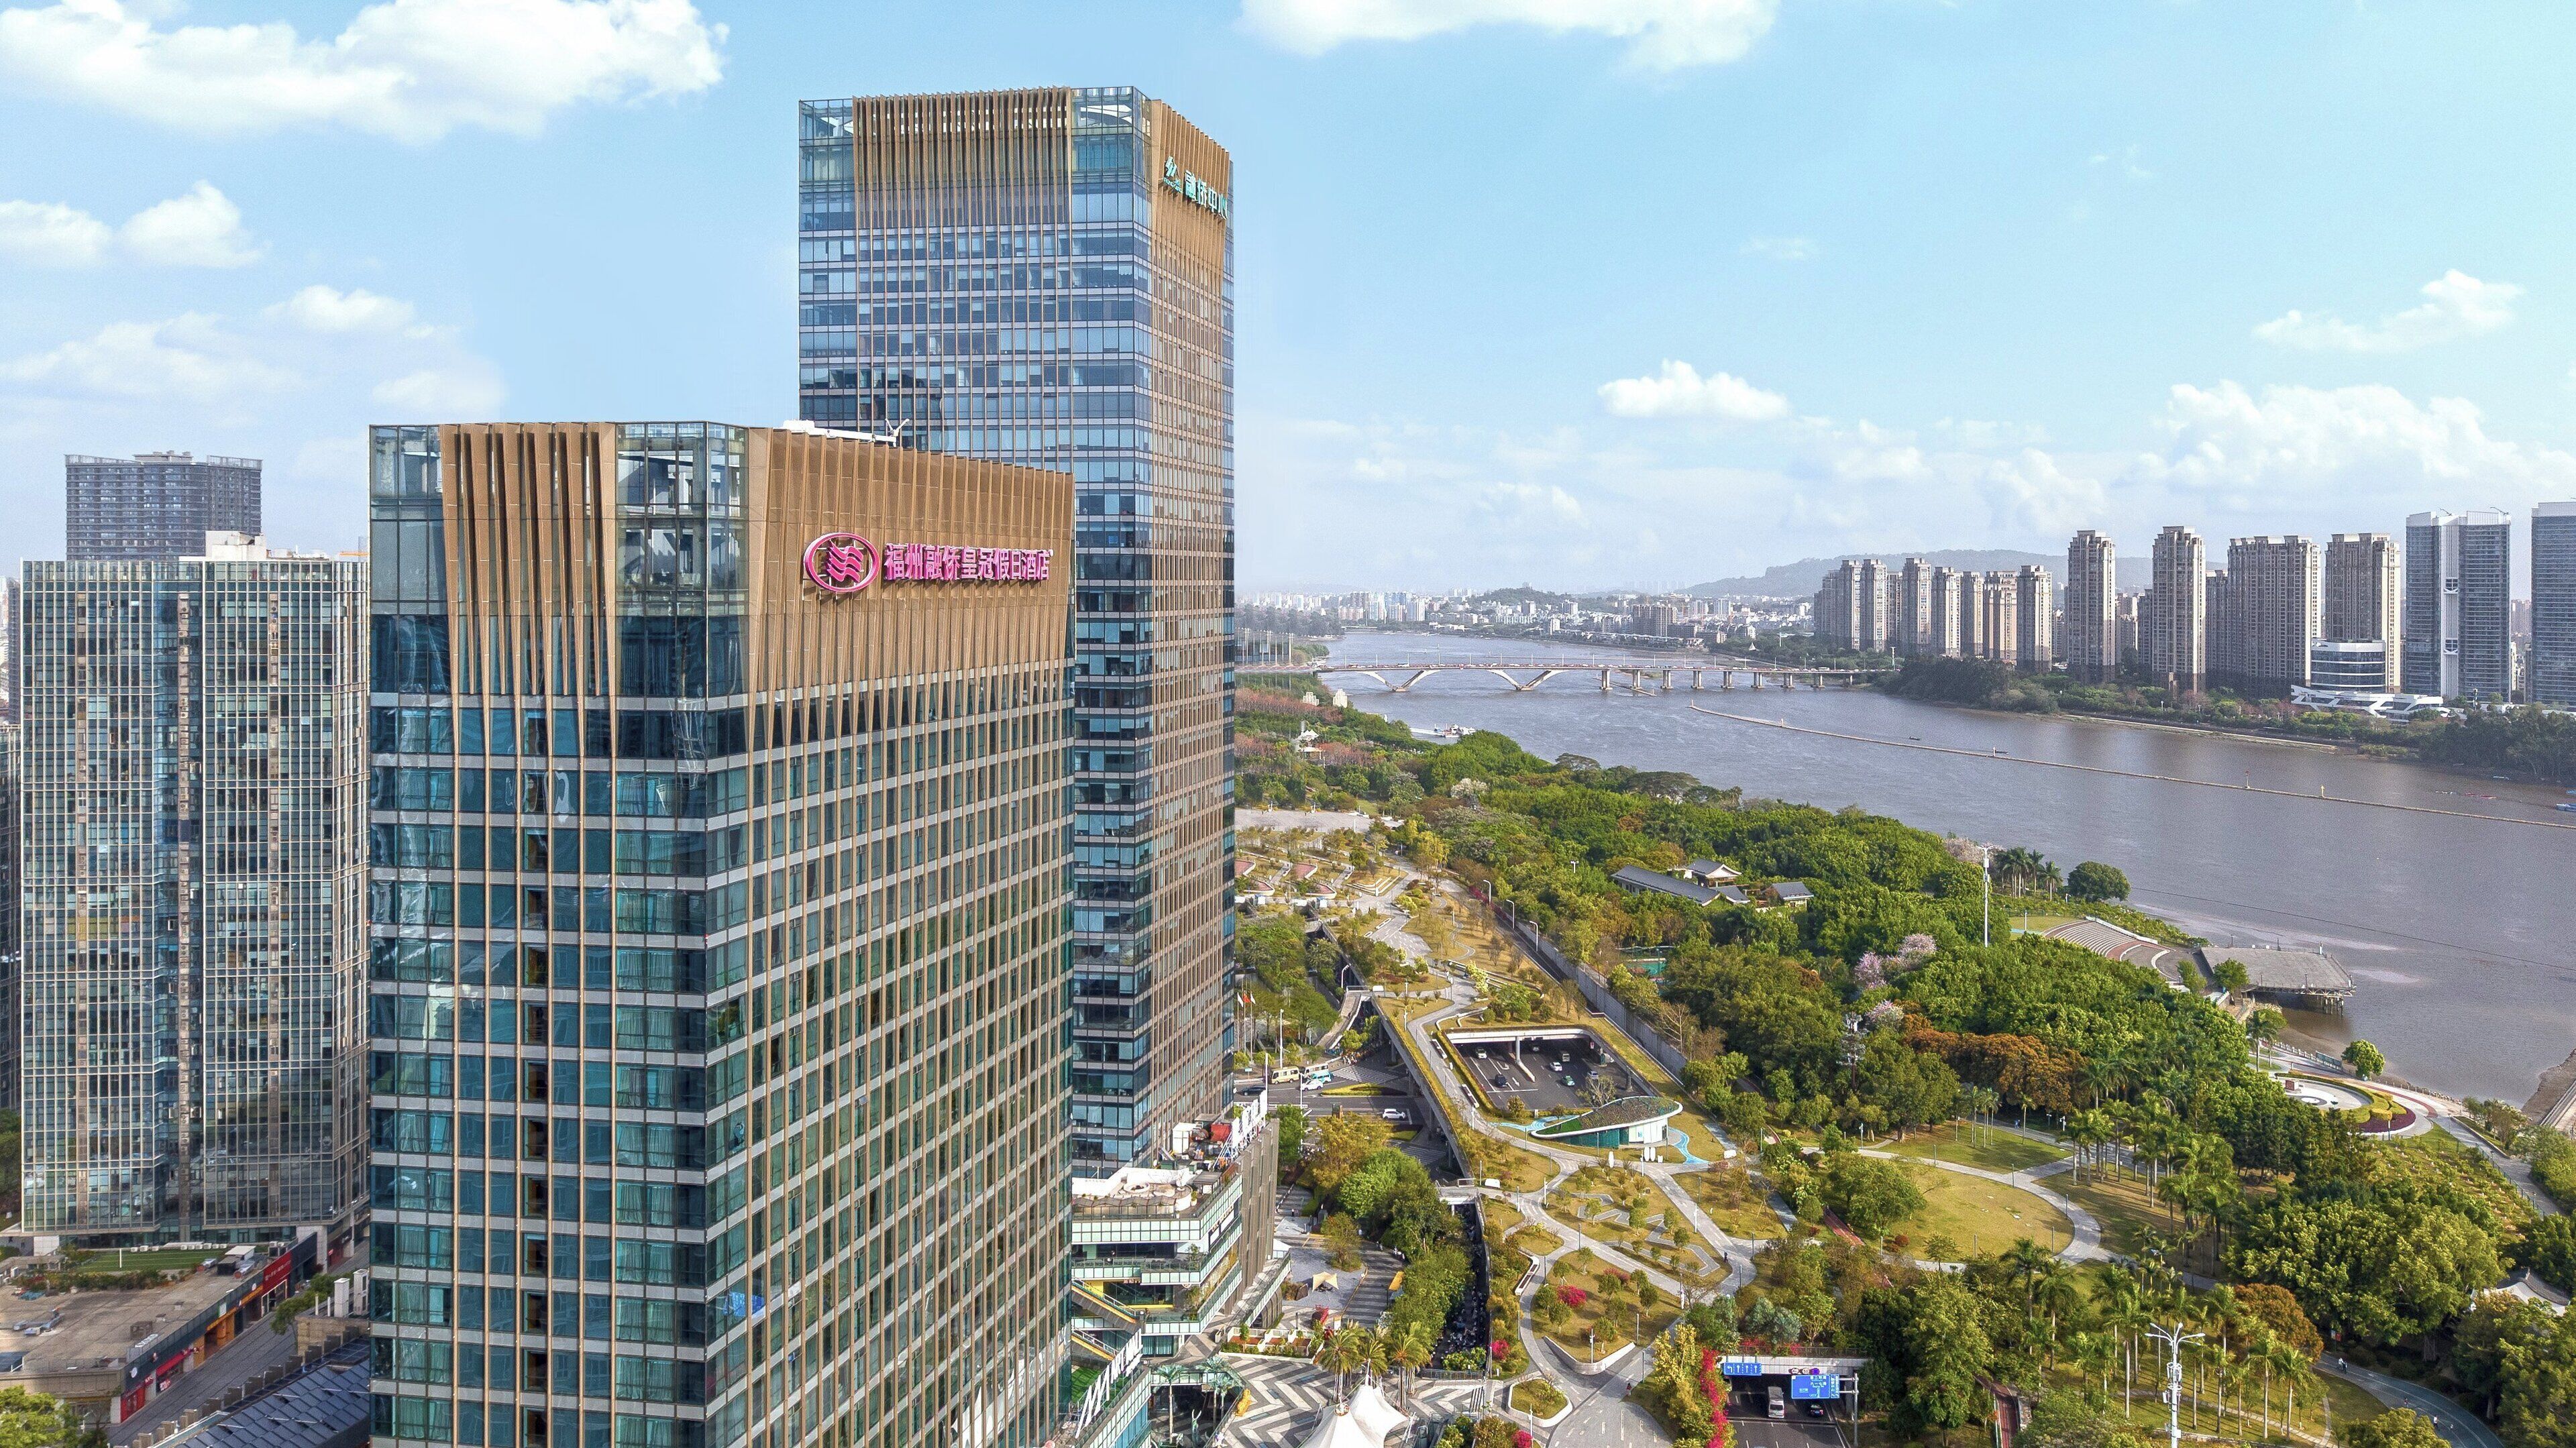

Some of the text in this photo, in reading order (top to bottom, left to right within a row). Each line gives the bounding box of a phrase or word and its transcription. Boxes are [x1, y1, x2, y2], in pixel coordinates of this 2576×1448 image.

[884, 543, 1050, 580] 福州融侨皇冠假日酒店
